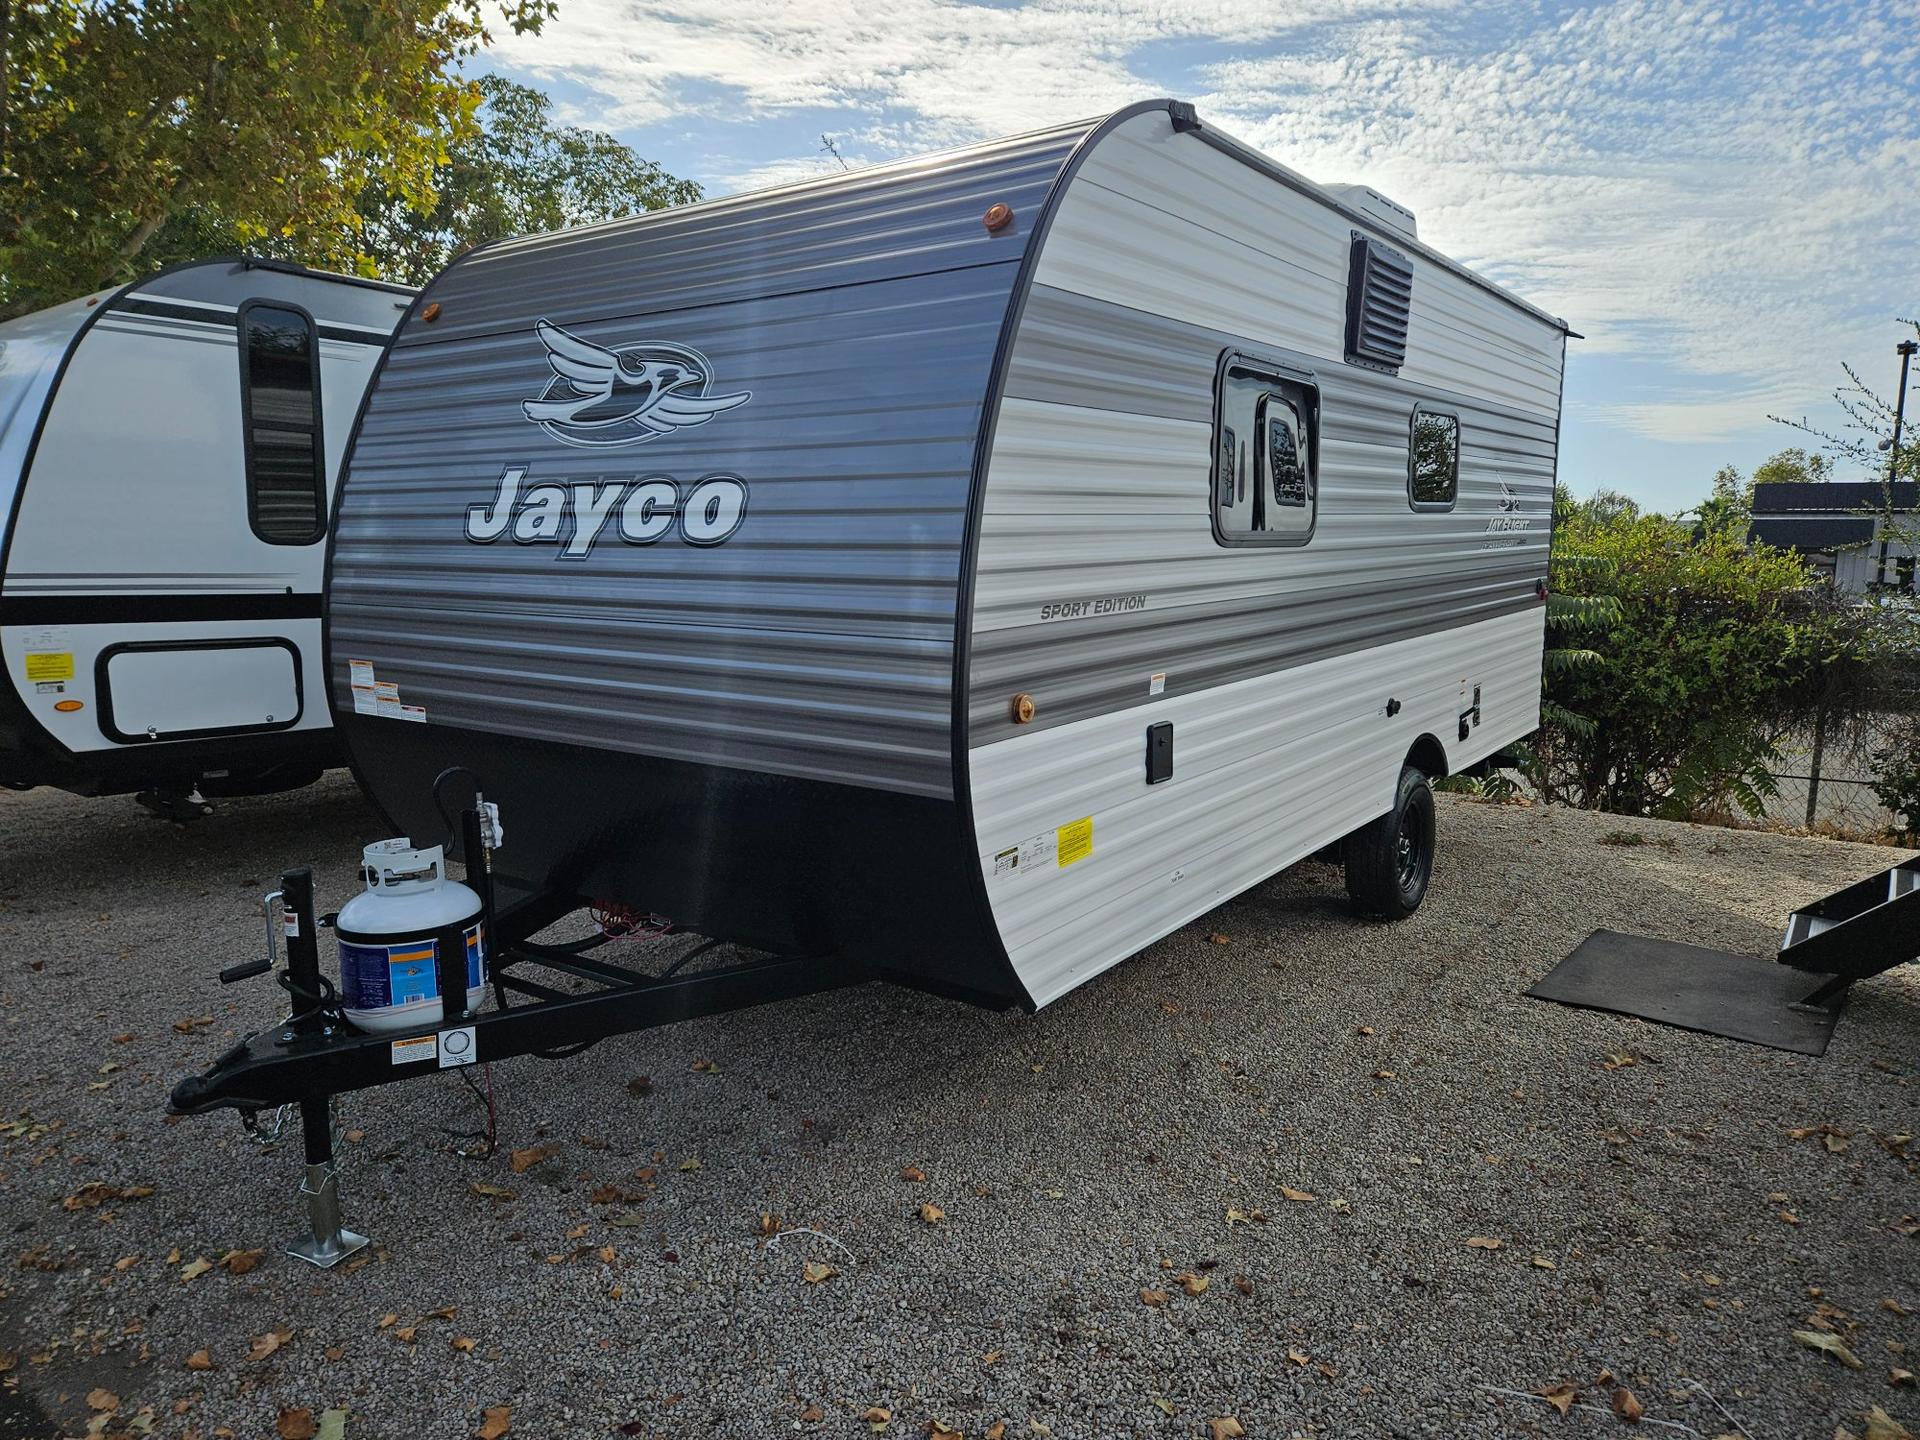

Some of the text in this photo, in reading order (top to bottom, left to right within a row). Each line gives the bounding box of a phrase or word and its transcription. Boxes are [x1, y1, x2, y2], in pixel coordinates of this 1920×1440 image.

[465, 463, 749, 560] Jayco
[1486, 516, 1530, 534] JAY FLIGHT
[1041, 595, 1146, 619] SPORT EDITION
